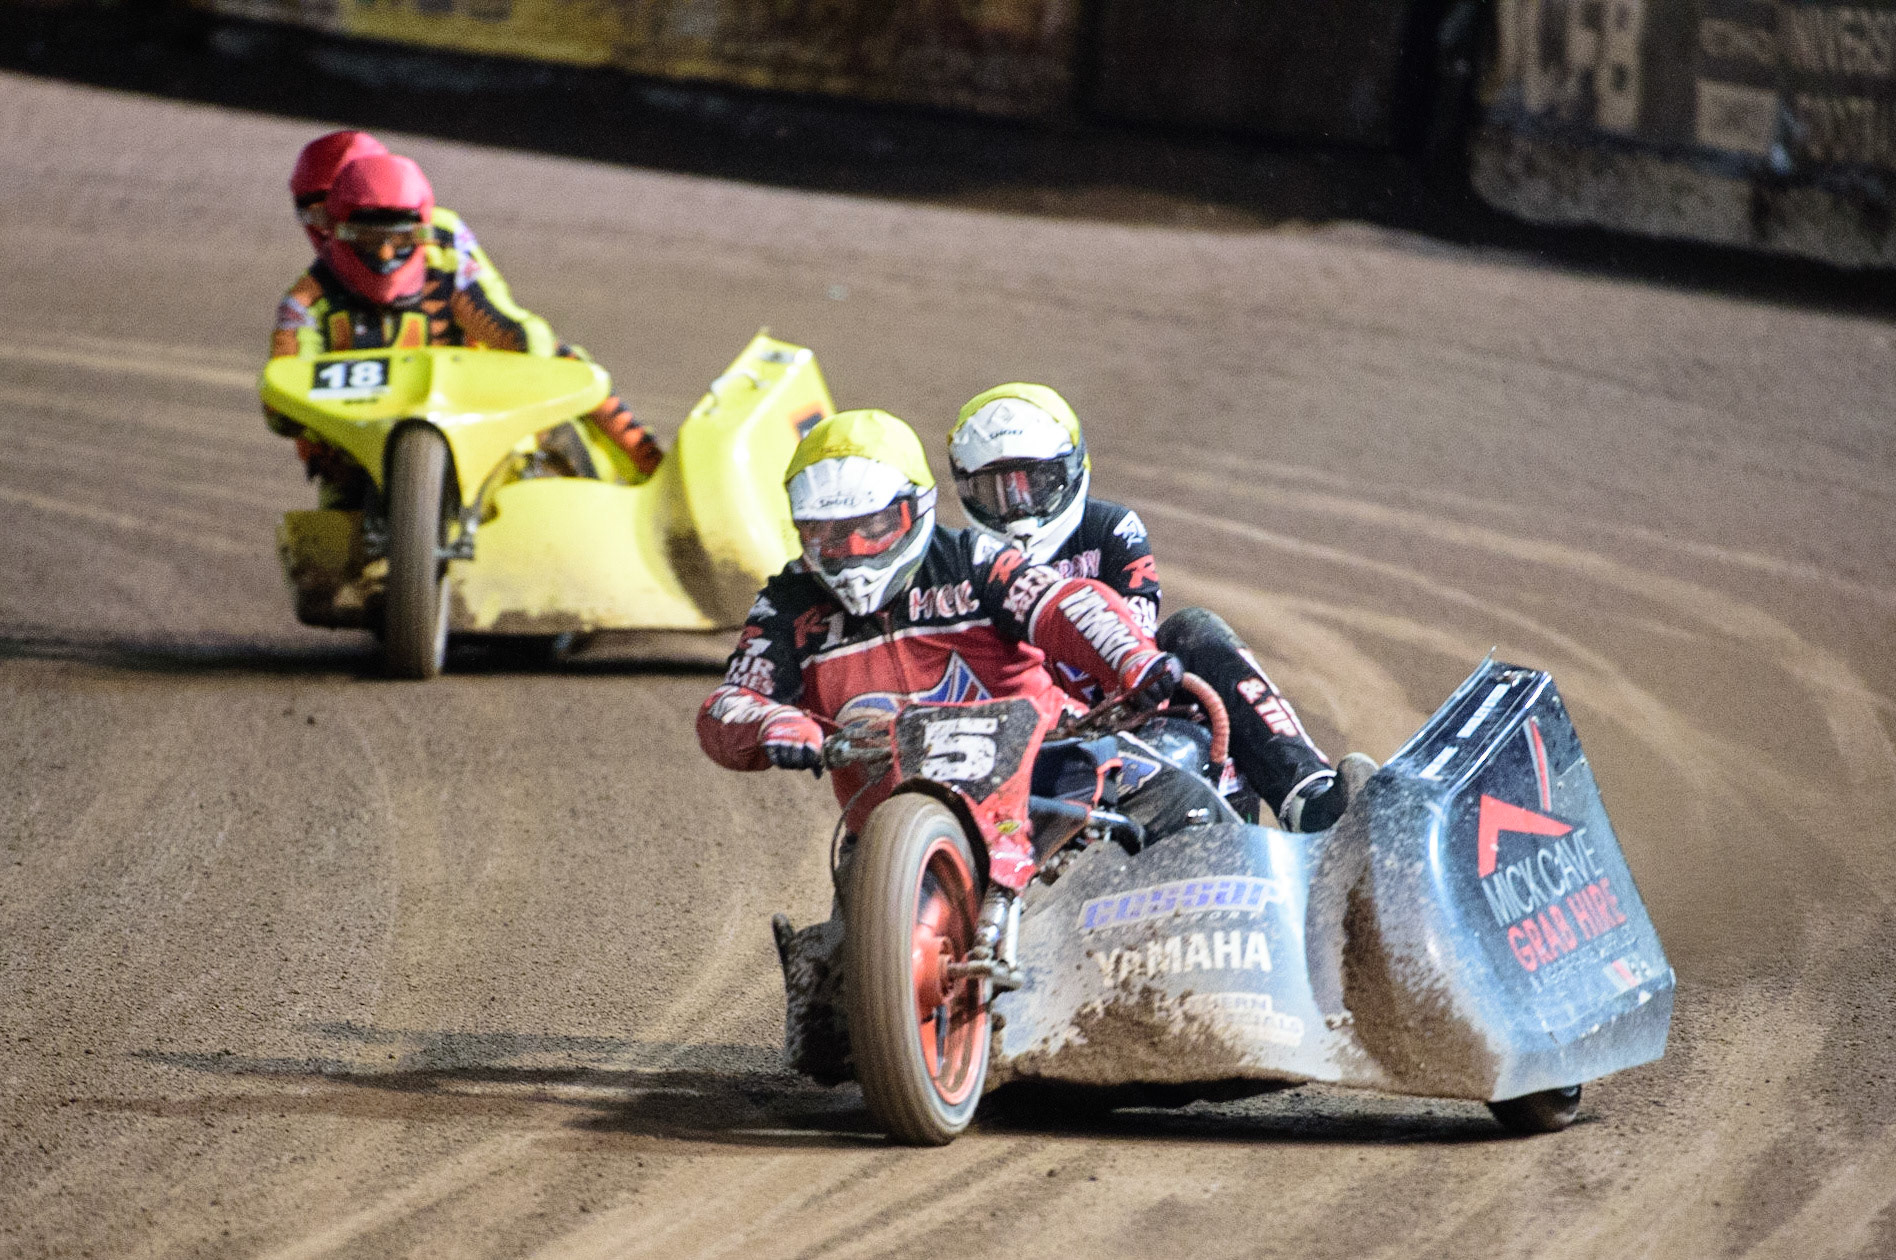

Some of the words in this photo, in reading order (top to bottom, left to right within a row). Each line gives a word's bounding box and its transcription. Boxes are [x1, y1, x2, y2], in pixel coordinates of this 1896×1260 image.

[319, 361, 383, 389] 18
[1254, 695, 1300, 738] TIP
[920, 717, 999, 782] 5
[1481, 856, 1549, 928] MICK
[1537, 827, 1605, 897] CAVE
[1094, 930, 1273, 988] YAMAHA
[1507, 904, 1578, 973] GRAB
